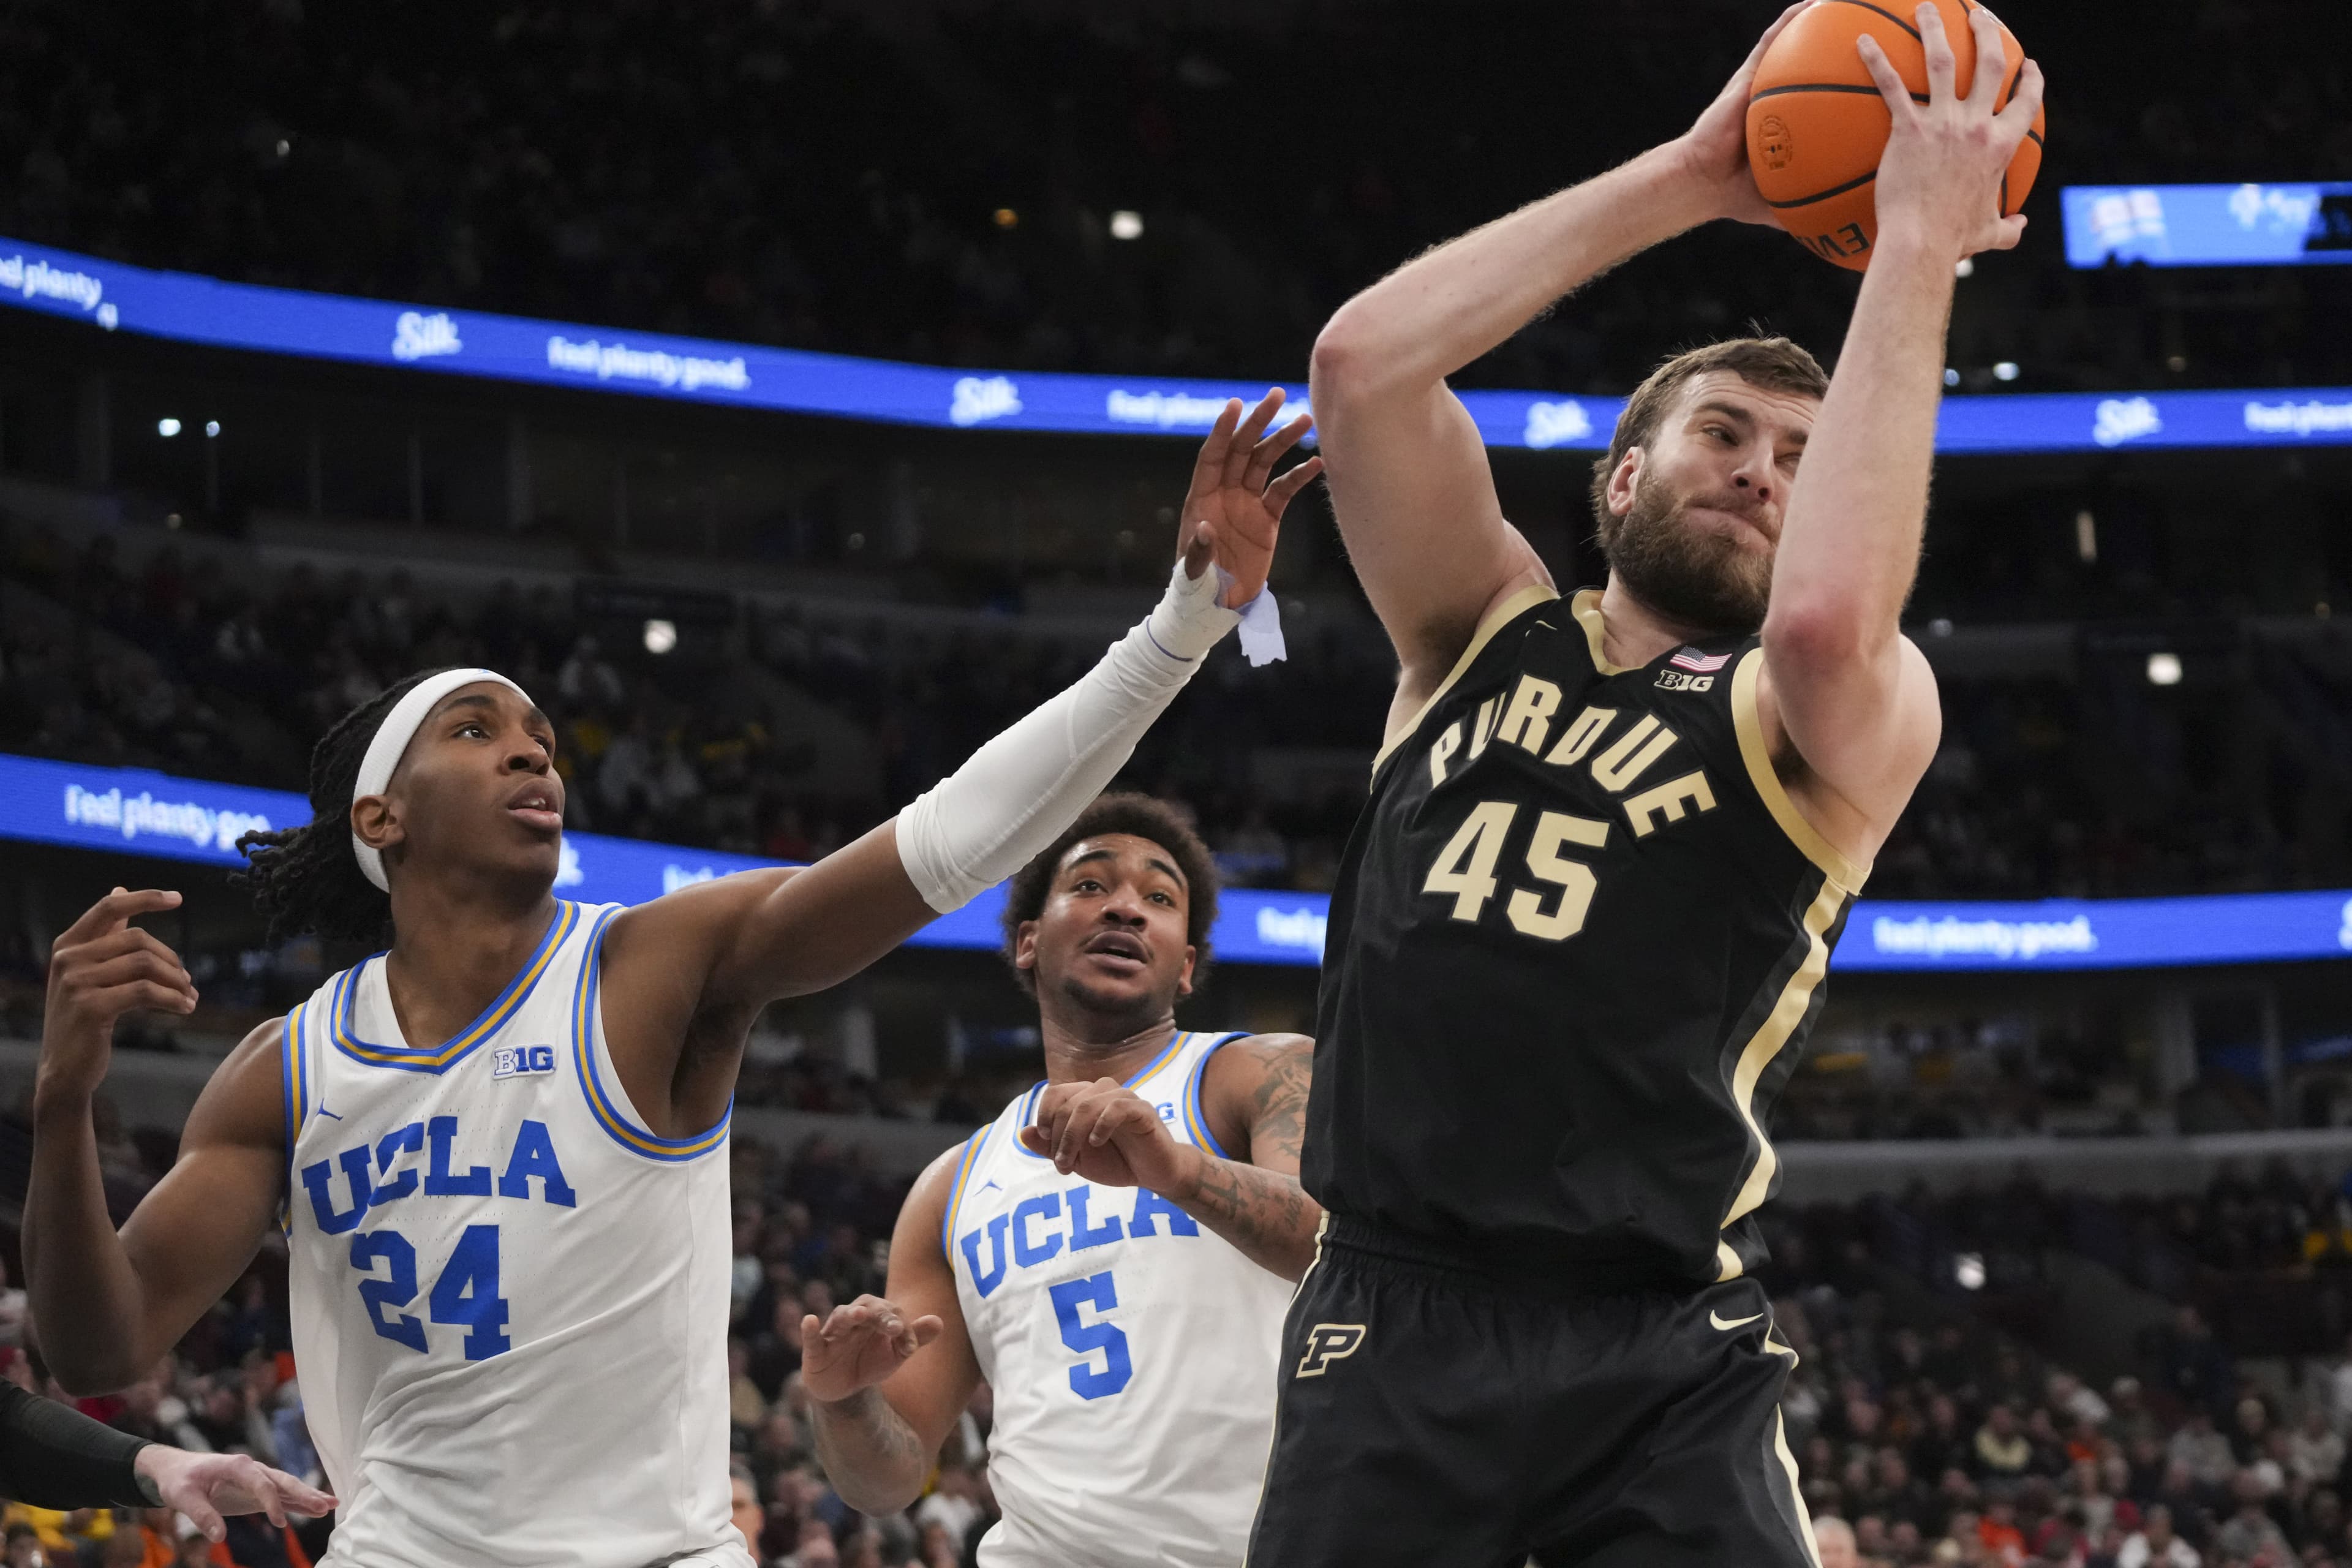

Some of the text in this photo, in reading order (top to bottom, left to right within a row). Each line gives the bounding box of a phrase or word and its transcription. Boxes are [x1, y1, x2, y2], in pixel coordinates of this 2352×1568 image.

[1429, 673, 1717, 840] PURDUE
[1420, 801, 1610, 941] 45
[301, 1116, 577, 1235] UCLA
[349, 1224, 511, 1361] 24
[960, 1184, 1200, 1299] UCLA
[1048, 1270, 1133, 1401] 5
[1295, 1323, 1366, 1379] P
